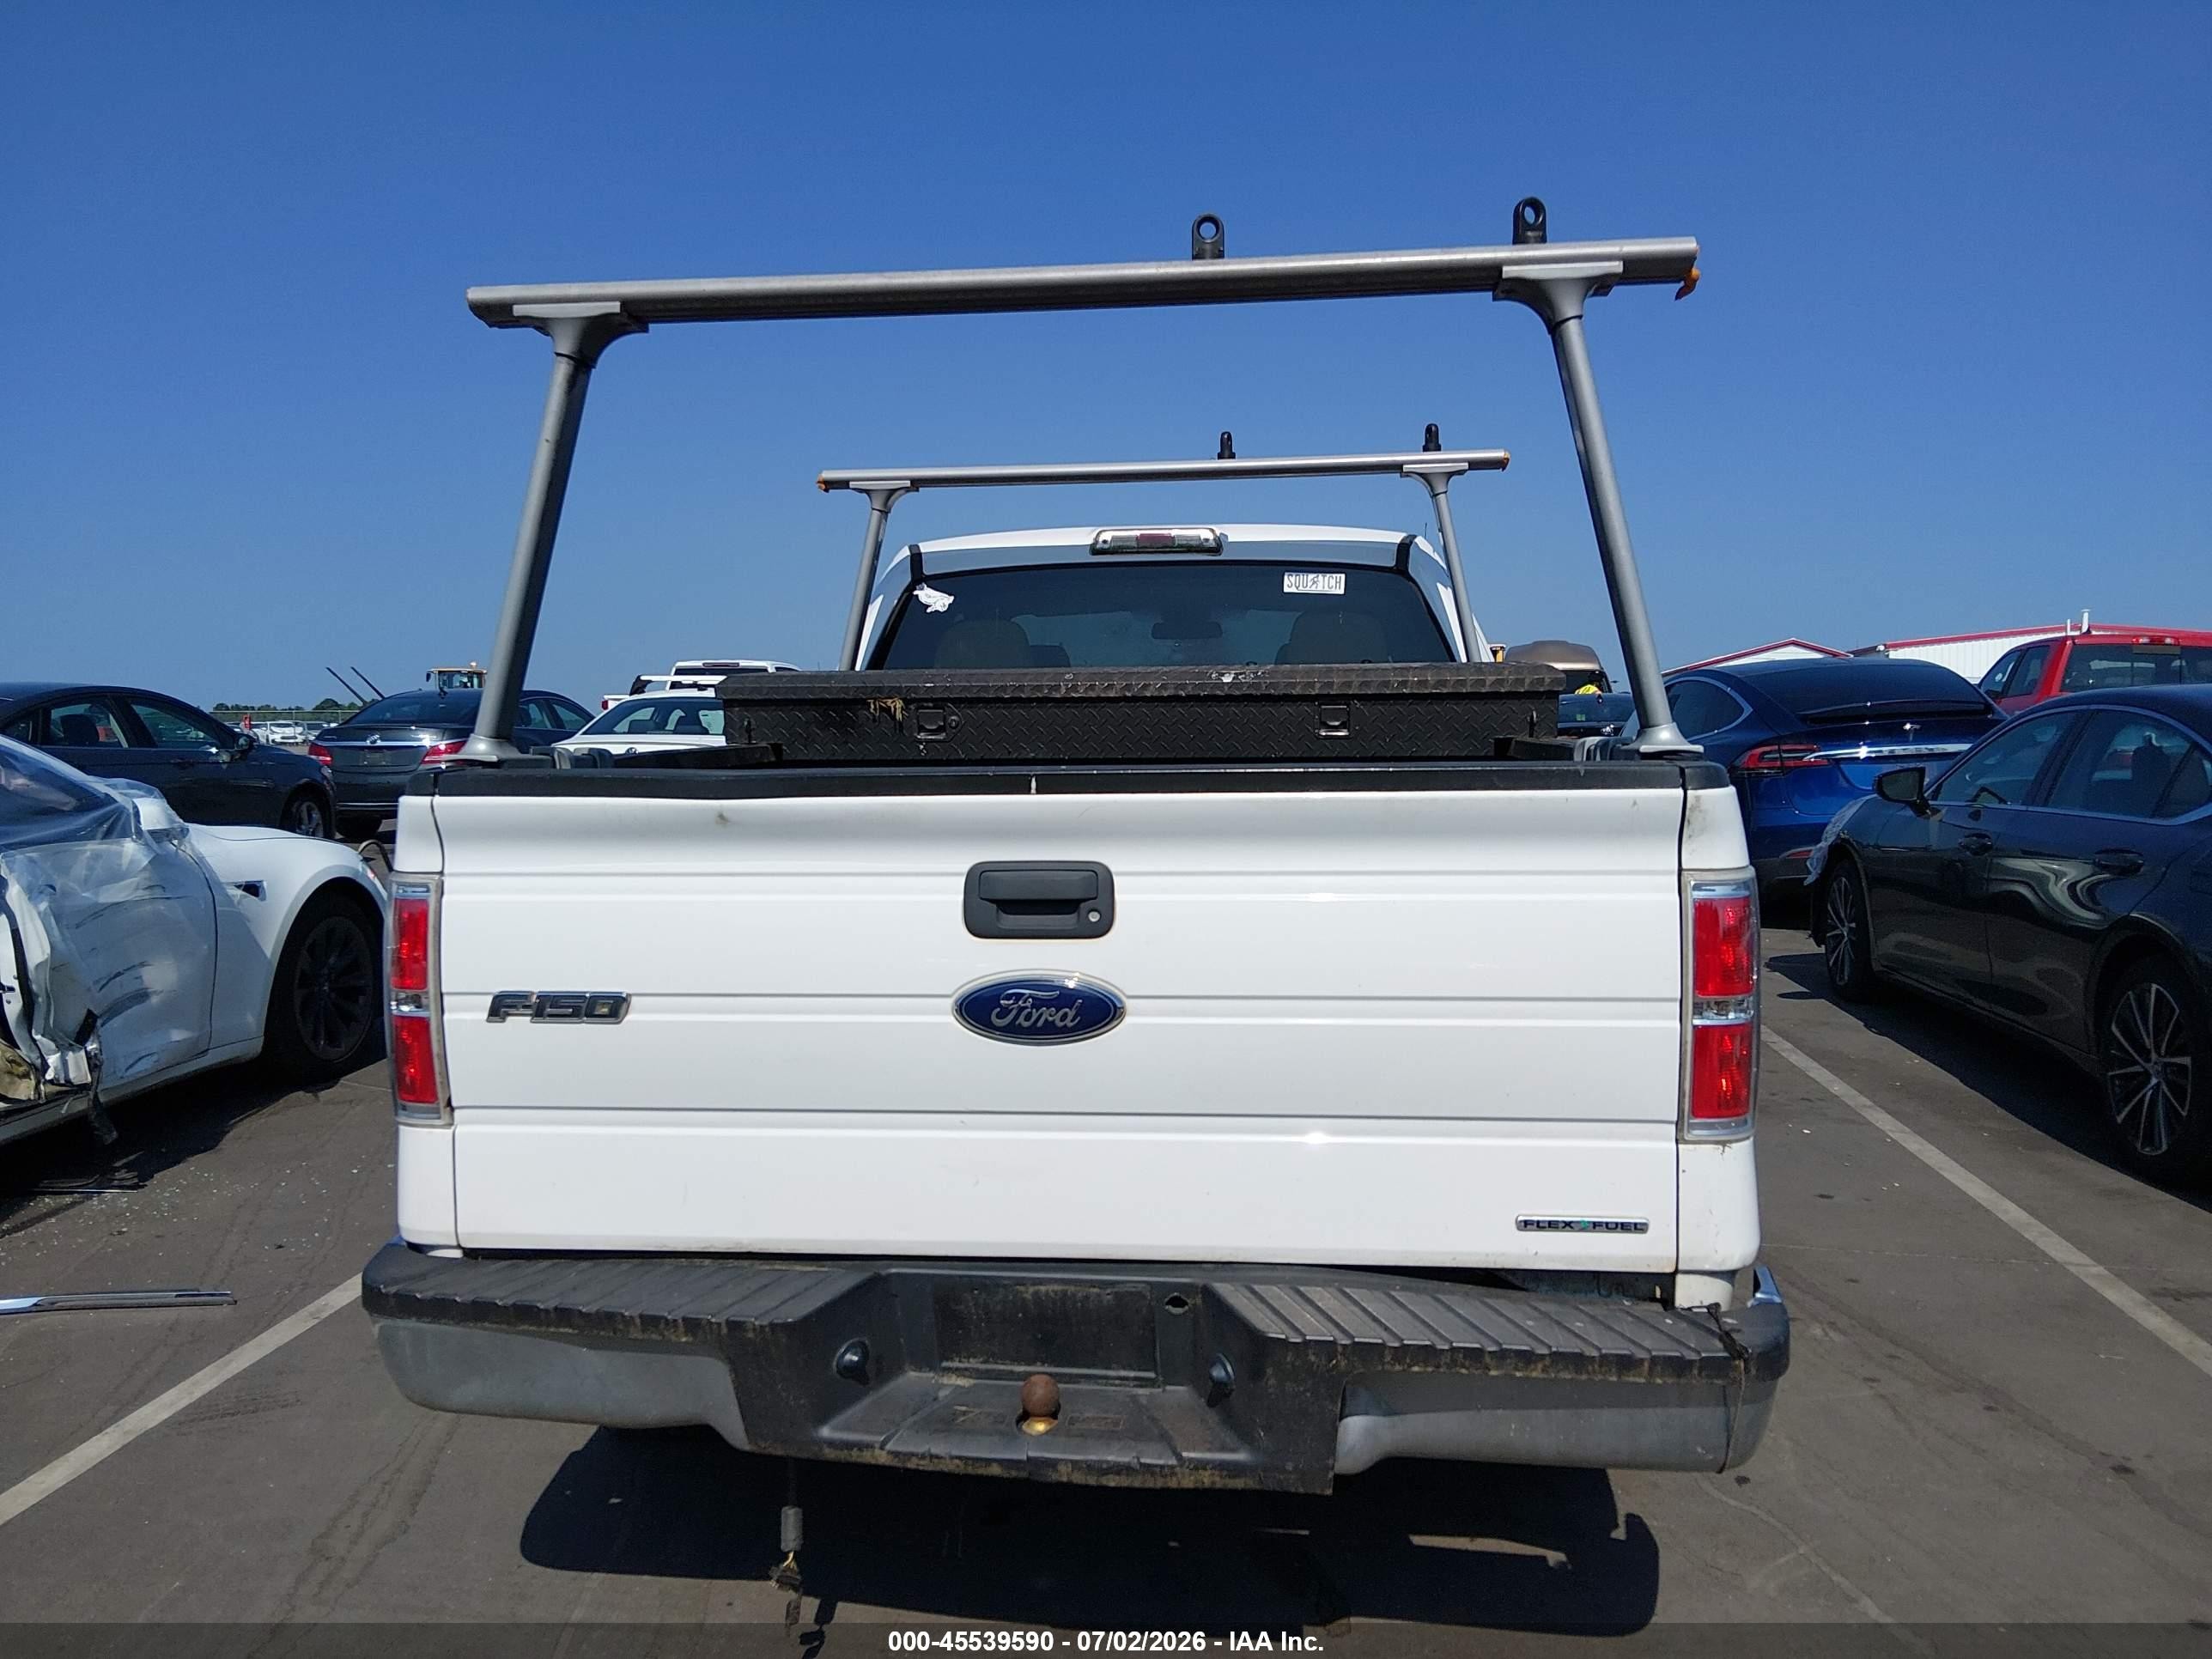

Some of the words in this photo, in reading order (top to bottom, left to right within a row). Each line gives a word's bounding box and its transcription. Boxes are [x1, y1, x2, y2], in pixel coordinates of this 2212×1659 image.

[990, 988, 1083, 1028] Ford
[1522, 1219, 1575, 1230] FLEX
[1592, 1220, 1645, 1231] FUEL
